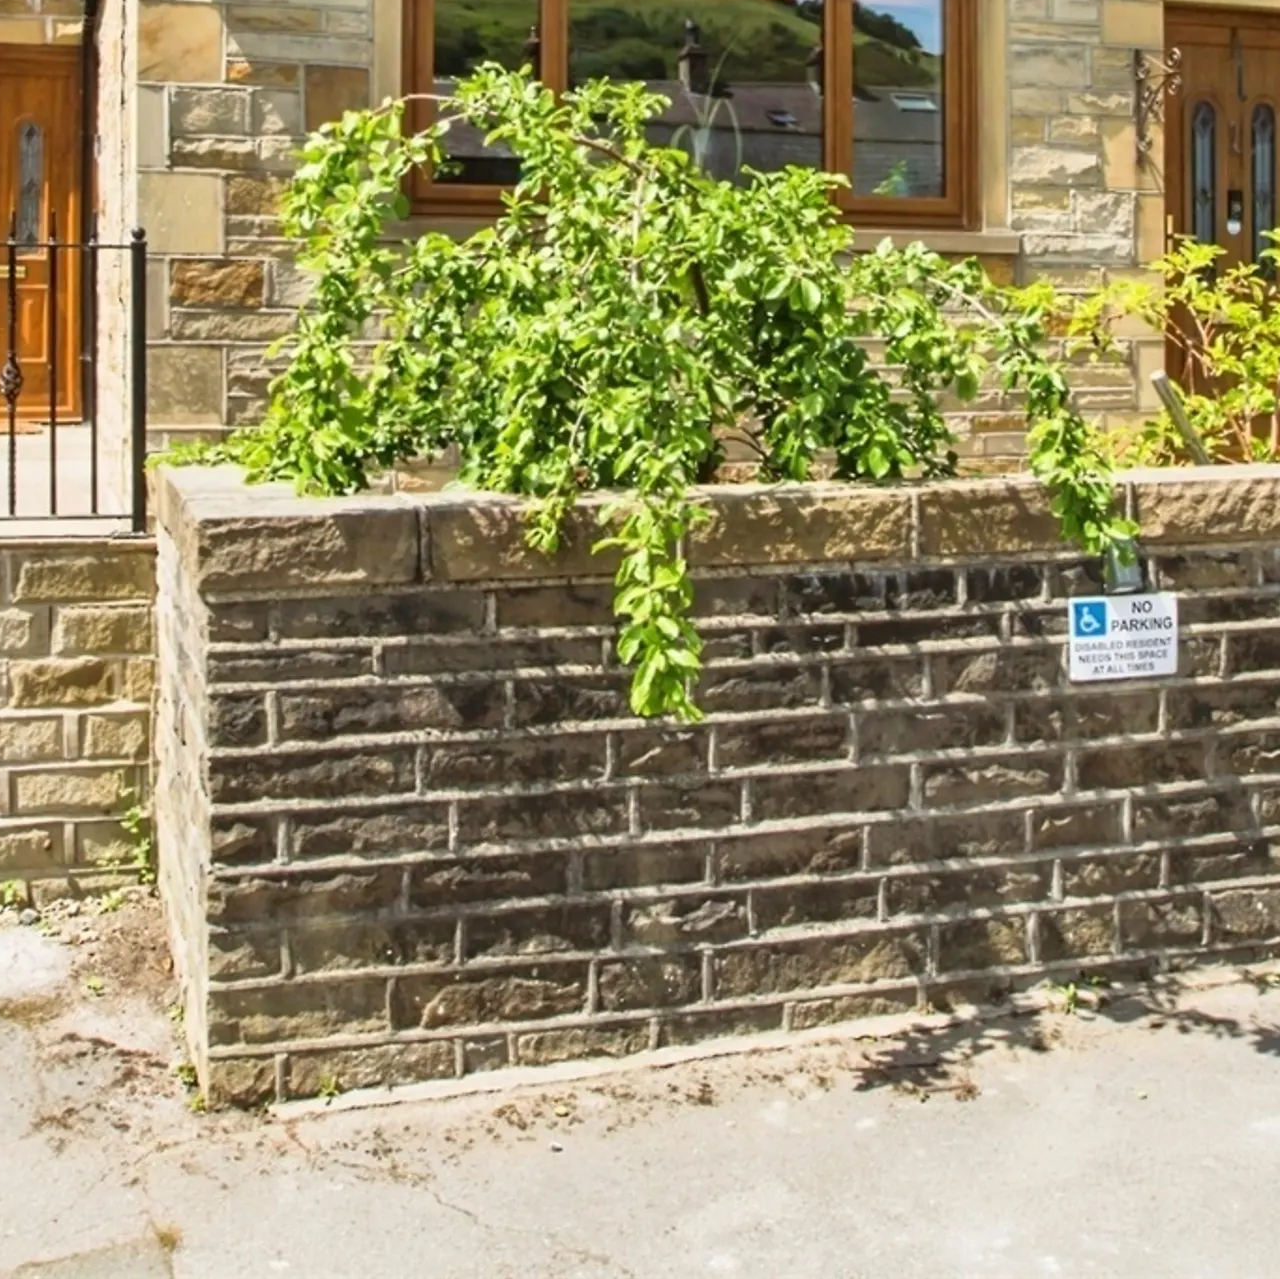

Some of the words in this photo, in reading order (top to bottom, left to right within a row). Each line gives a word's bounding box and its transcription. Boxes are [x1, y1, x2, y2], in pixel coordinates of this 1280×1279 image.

[1131, 601, 1153, 614] NO
[1111, 616, 1173, 632] PARKING
[1075, 641, 1123, 652] DISABLED
[1126, 637, 1172, 648] RESIDENT
[1078, 652, 1112, 664] NEEDS
[1114, 651, 1135, 661] THIS
[1138, 649, 1168, 659] SPACE
[1092, 665, 1105, 674] AT
[1107, 663, 1124, 673] ALL
[1127, 662, 1155, 671] TIMES
